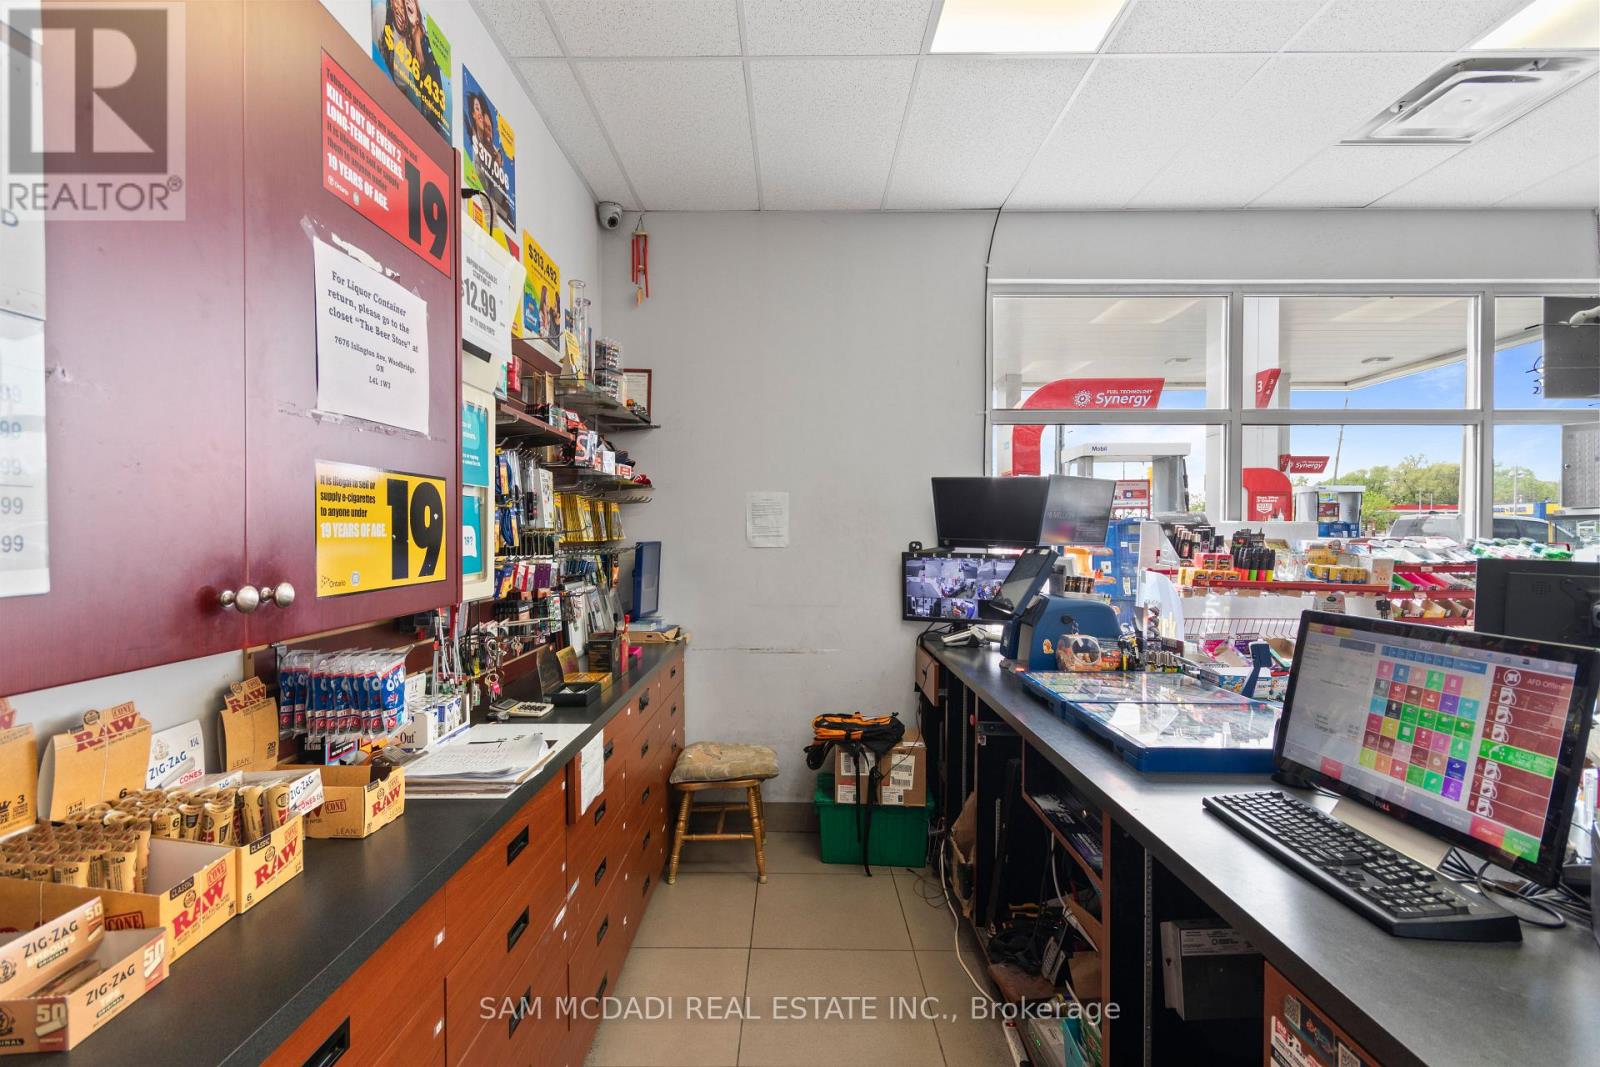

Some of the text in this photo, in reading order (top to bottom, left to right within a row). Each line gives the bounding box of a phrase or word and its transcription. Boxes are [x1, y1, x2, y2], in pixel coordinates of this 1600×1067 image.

[326, 66, 351, 100] Tobacco
[352, 93, 376, 124] products
[326, 81, 401, 163] KILL 1 OUT OF EVERY 2
[326, 99, 403, 182] LONG-TERM SMOKERS.
[327, 151, 388, 212] 19 YEARS OF AGE.
[405, 158, 447, 260] 19
[331, 271, 407, 317] For Liquor Container
[328, 289, 410, 334] return, please go to the
[328, 306, 419, 353] closet "The Beer Store" at
[334, 336, 350, 347] 7676
[351, 341, 375, 358] Islington
[376, 364, 384, 373] ON
[1256, 380, 1263, 393] 3
[1095, 393, 1151, 407] Synergy
[352, 479, 359, 488] to
[359, 479, 369, 489] sell
[369, 481, 375, 490] or
[320, 491, 375, 504] supply e-cigarettes
[320, 506, 367, 518] to anyone under
[320, 522, 387, 538] 19 YEARS OF AGE.
[387, 478, 444, 580] 19
[329, 579, 346, 588] Ontario
[1527, 678, 1541, 687] AFD
[228, 686, 266, 713] RAW
[73, 712, 138, 753] RAW
[400, 731, 415, 744] Out
[149, 750, 187, 780] ZIG-ZAG
[233, 758, 249, 768] LEAN
[179, 769, 203, 784] CONES
[290, 775, 314, 800] ZIG-ZAG
[17, 794, 24, 804] 3
[119, 788, 127, 799] 6
[371, 784, 401, 818] RAW
[326, 801, 345, 812] CONE
[172, 817, 180, 828] 6
[208, 861, 226, 884] CONE
[254, 838, 298, 889] RAW
[171, 877, 194, 899] CLASSIC
[83, 901, 103, 921] 50
[172, 875, 226, 940] RAW
[107, 914, 142, 930] CONE
[22, 920, 78, 959] ZIG-ZAG
[144, 938, 165, 967] 50
[86, 961, 135, 1007] ZIG-ZAG
[36, 1003, 66, 1023] 50
